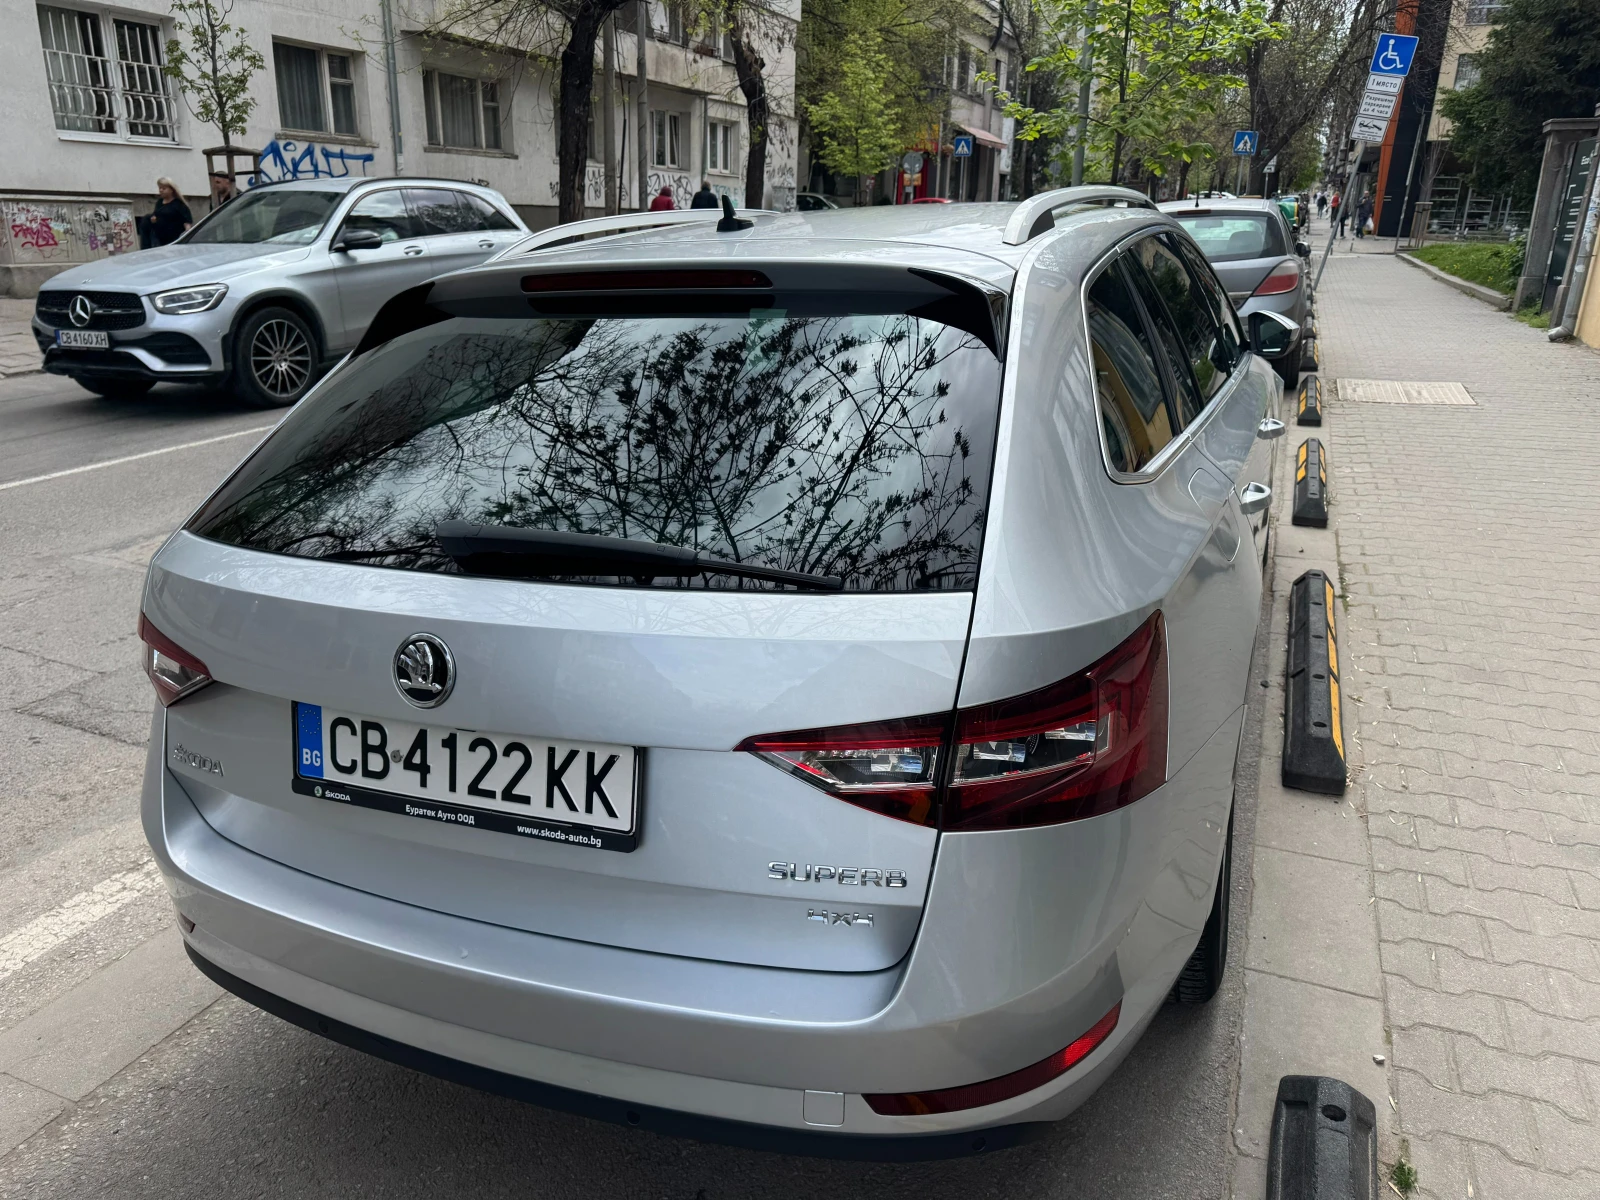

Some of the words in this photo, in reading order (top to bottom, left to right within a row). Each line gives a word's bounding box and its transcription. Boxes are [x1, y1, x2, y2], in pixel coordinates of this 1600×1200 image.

[73, 332, 93, 345] 4160
[302, 747, 321, 768] BG
[402, 728, 532, 805] 4122
[405, 804, 436, 817] Еуратек
[437, 809, 456, 823] Ауто
[457, 813, 475, 825] ООД
[516, 824, 602, 848] www.skoda-auto.bg
[768, 860, 908, 888] SUPERB
